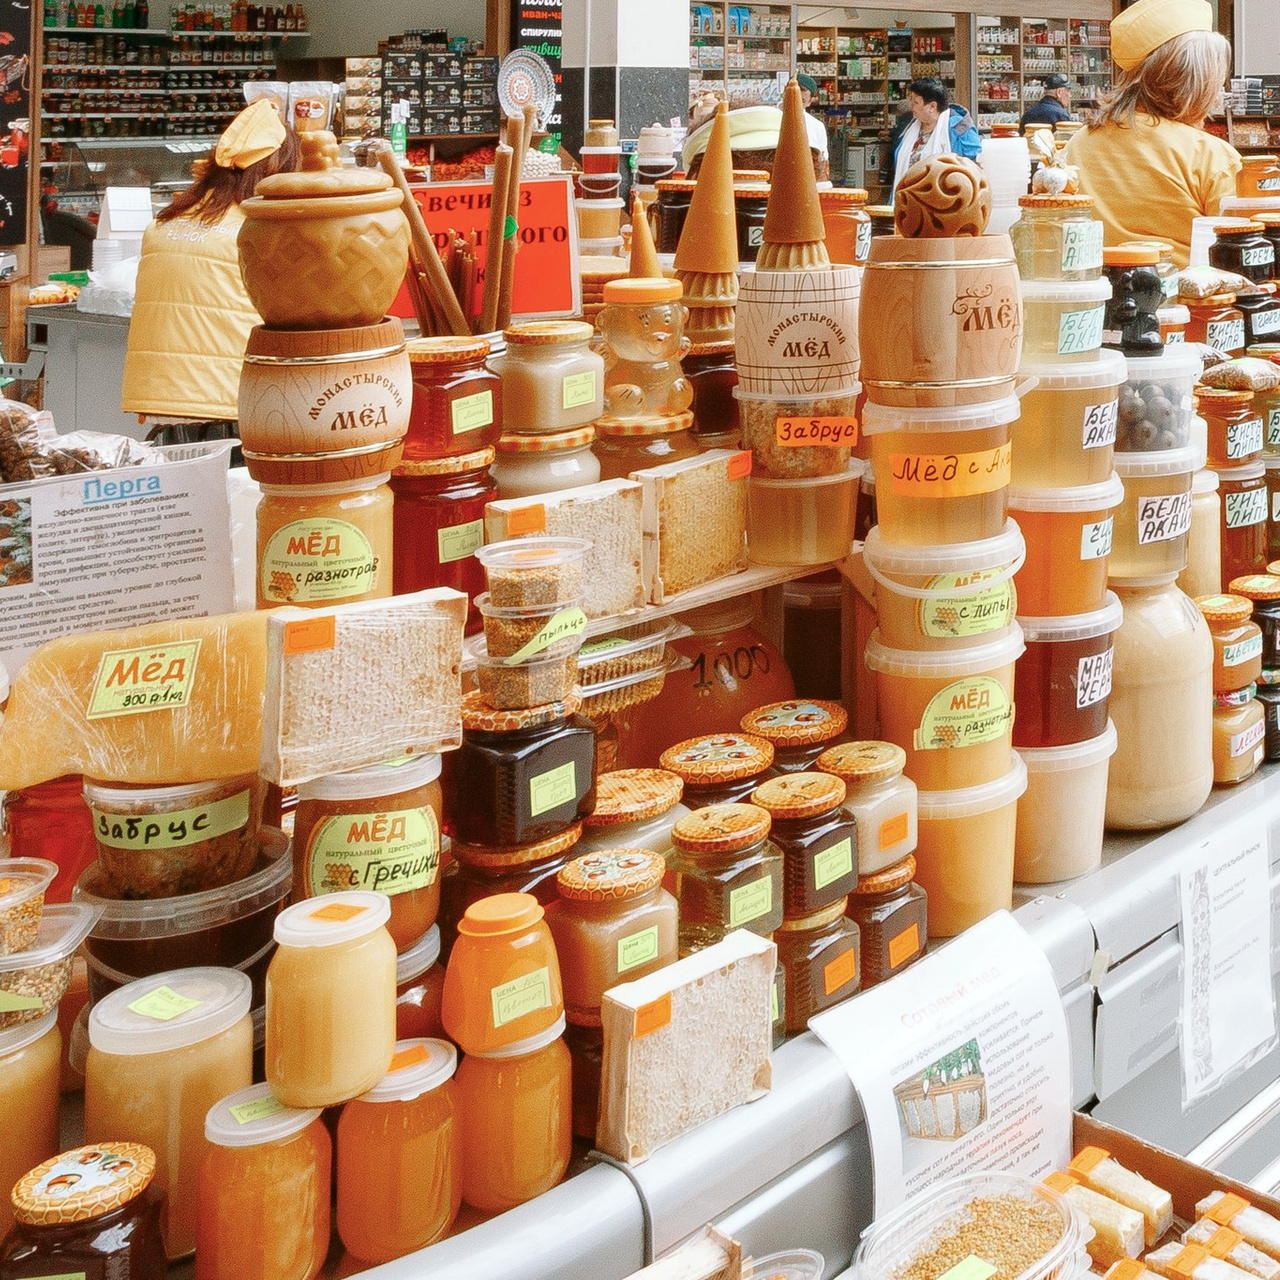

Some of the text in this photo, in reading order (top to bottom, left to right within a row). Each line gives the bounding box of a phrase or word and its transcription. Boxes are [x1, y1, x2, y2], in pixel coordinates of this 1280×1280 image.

[767, 312, 847, 347] МОНАСТЫРСКИЙ
[783, 337, 831, 359] МЁД
[330, 403, 388, 431] МЁД
[779, 420, 855, 442] Забрус
[893, 455, 980, 482] Мёд с
[83, 475, 161, 502] Перга
[53, 489, 188, 518] Эффективна при заболеваниях
[38, 528, 70, 540] желудка
[38, 529, 195, 559] содержание гемоглобина эритроцитов
[108, 536, 203, 557] устойчивость организма
[286, 531, 341, 557] МЁД
[113, 551, 164, 566] способствует
[271, 555, 366, 569] натуральный цветочный
[296, 558, 379, 586] с разнотрав
[959, 597, 1010, 619] с липы
[538, 616, 584, 644] Пыльца
[106, 653, 186, 688] Мёд
[692, 645, 770, 688] 1000
[123, 693, 147, 707] 300
[950, 688, 990, 711] МЁД
[933, 713, 975, 722] натуральный
[347, 814, 407, 843] МЁД
[325, 838, 427, 860] натуральный цветочный
[350, 851, 440, 891] с Гречихи
[901, 983, 967, 1029] Сотовый
